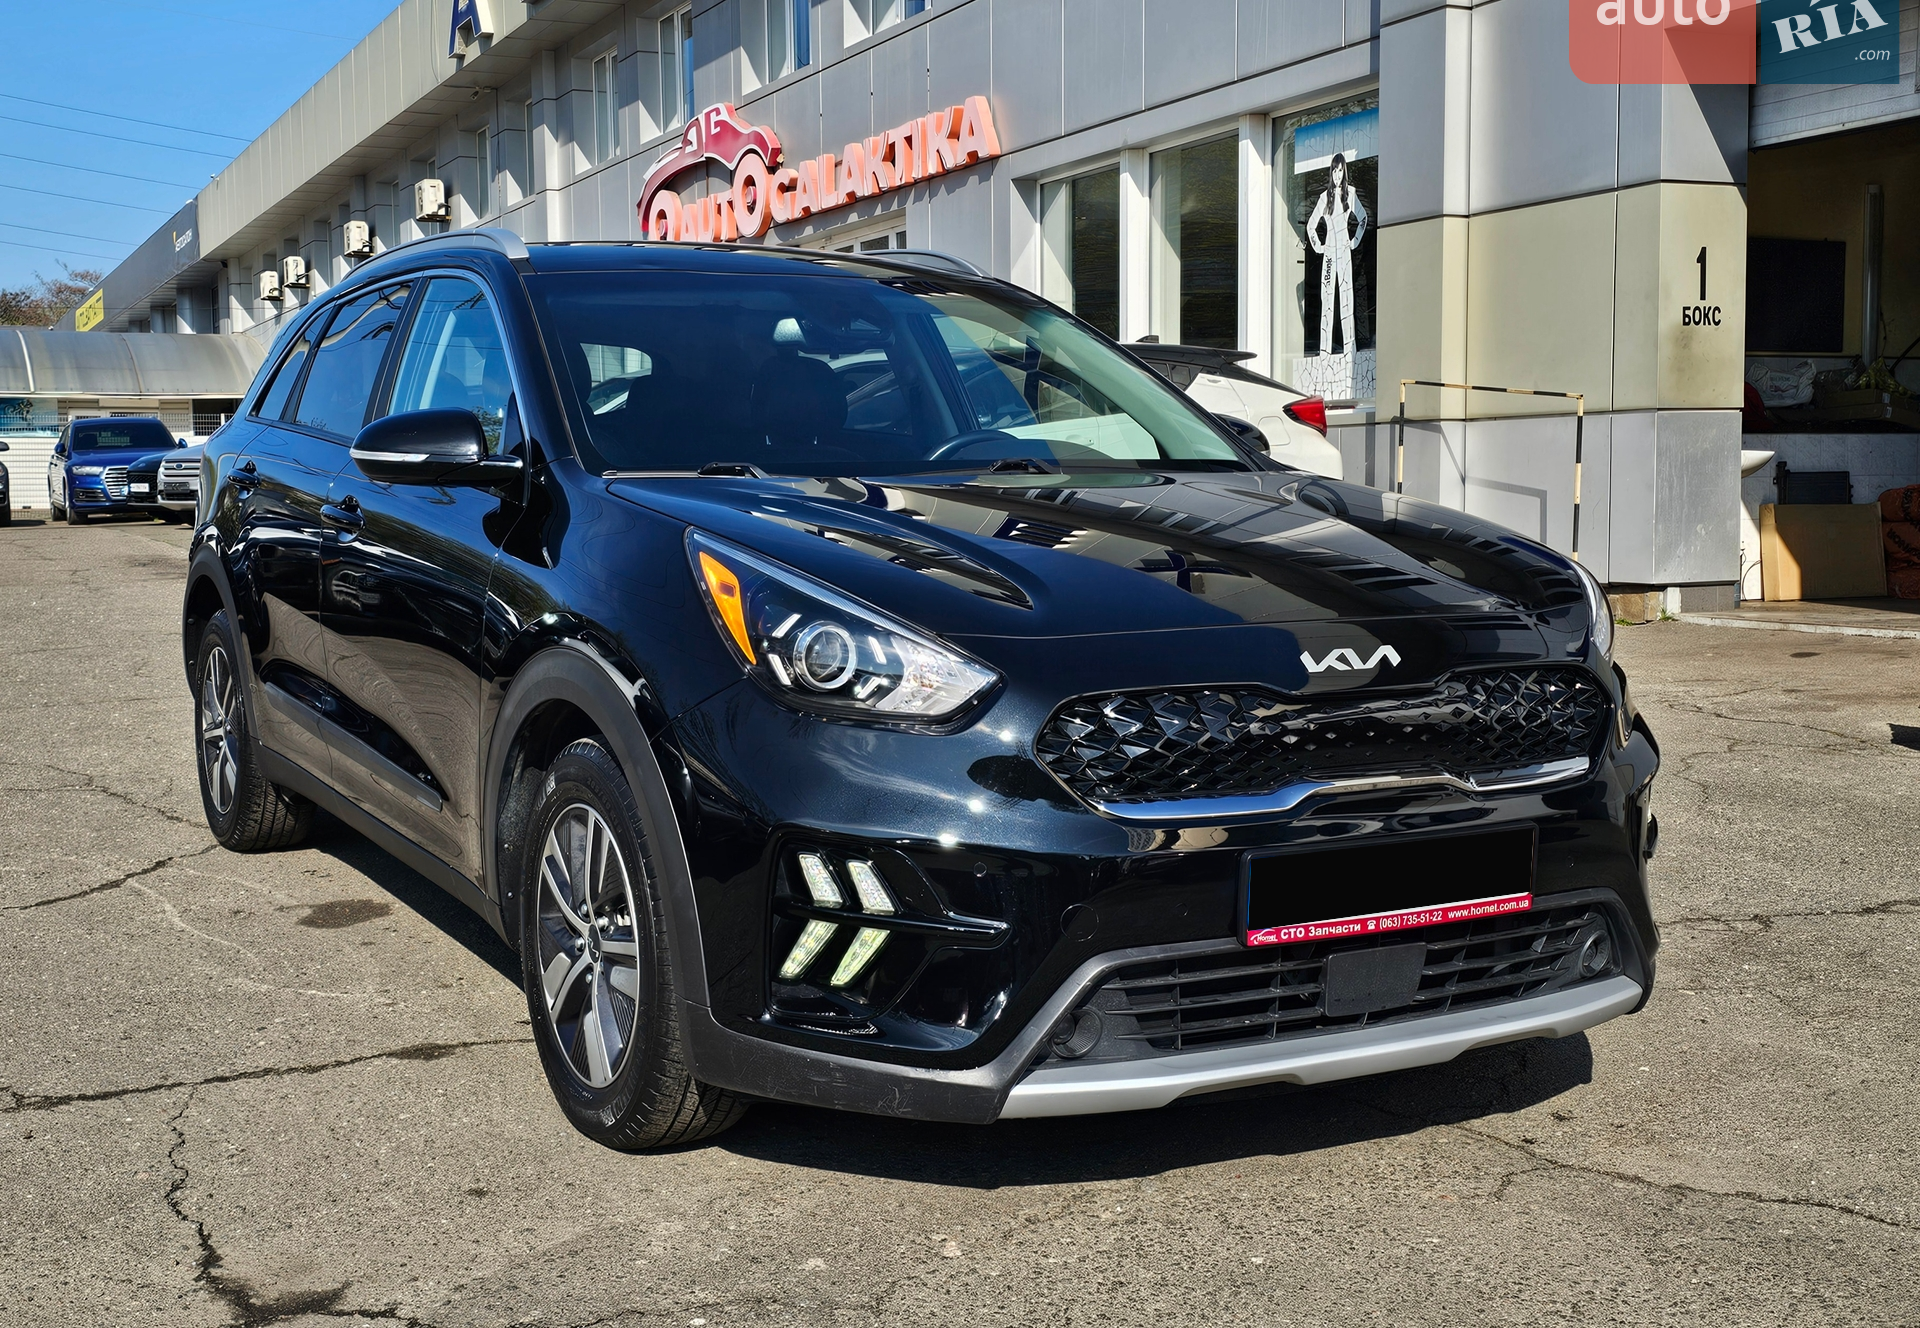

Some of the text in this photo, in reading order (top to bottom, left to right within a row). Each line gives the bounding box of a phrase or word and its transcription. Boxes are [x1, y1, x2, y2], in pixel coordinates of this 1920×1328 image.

[1696, 246, 1707, 301] 1
[1682, 305, 1722, 326] БОКС
[1280, 899, 1529, 939] СТО Запчасти (063) 735-51-22 www.hornet.com.ua
